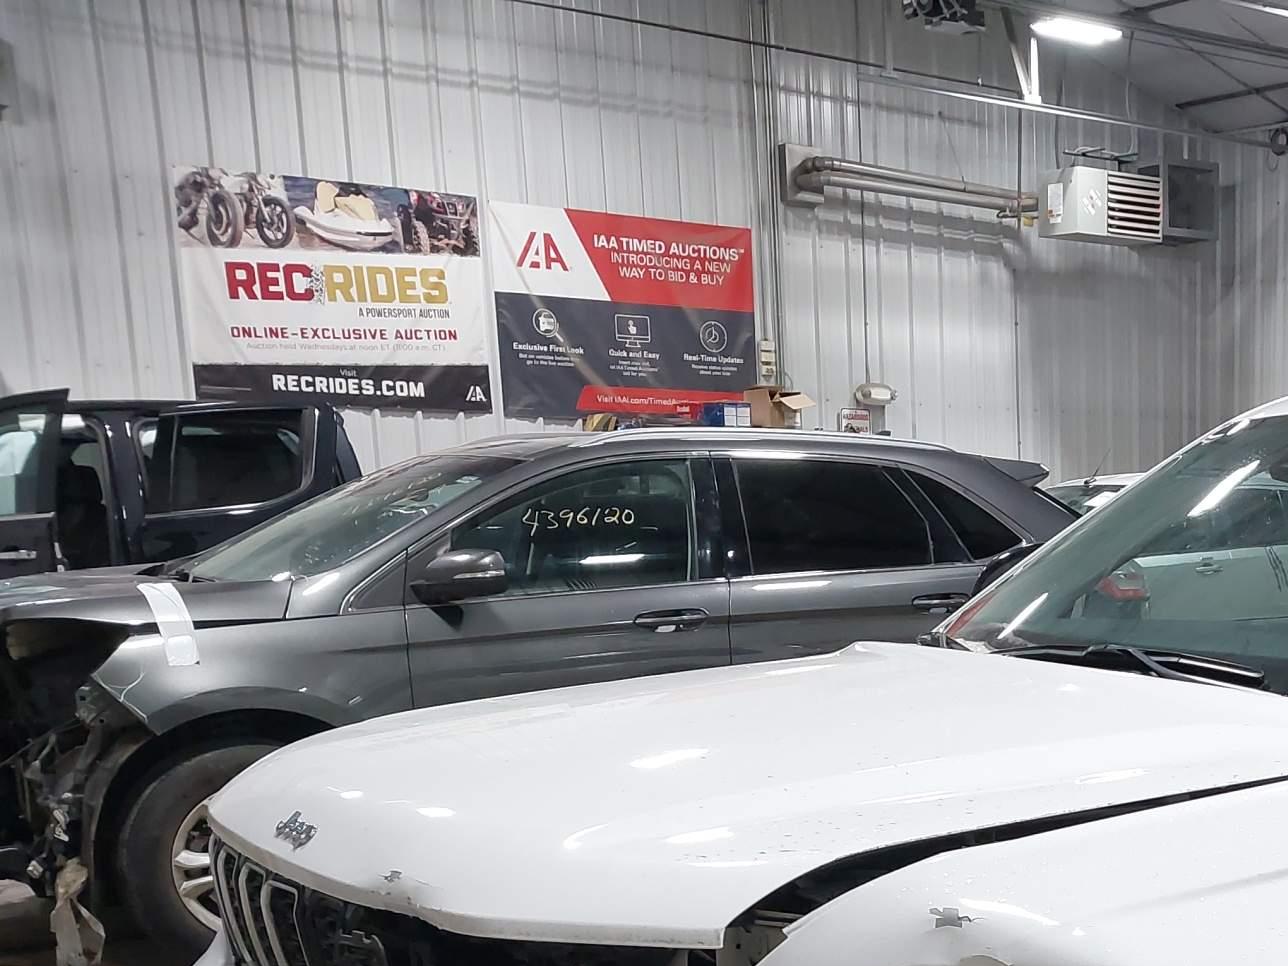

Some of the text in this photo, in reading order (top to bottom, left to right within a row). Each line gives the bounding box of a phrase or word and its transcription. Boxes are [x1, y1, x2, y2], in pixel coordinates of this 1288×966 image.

[593, 234, 739, 261] IAA TIMED AUCTIONS
[610, 252, 731, 273] INTRODUCING A NEW
[618, 266, 724, 286] WAY TO BID & BUY
[358, 307, 450, 320] A POWERSPORT AUCTION
[230, 326, 459, 341] ONLINE-EXCLUSIVE AUCTION
[247, 342, 278, 350] Auction
[512, 342, 549, 352] Exclusive
[567, 346, 584, 355] Look
[608, 348, 660, 361] Quick and Easy
[683, 353, 744, 365] Real-Time Updates
[340, 368, 357, 377] Visit
[272, 373, 425, 398] RECRIDES.COM
[596, 394, 613, 404] Visit
